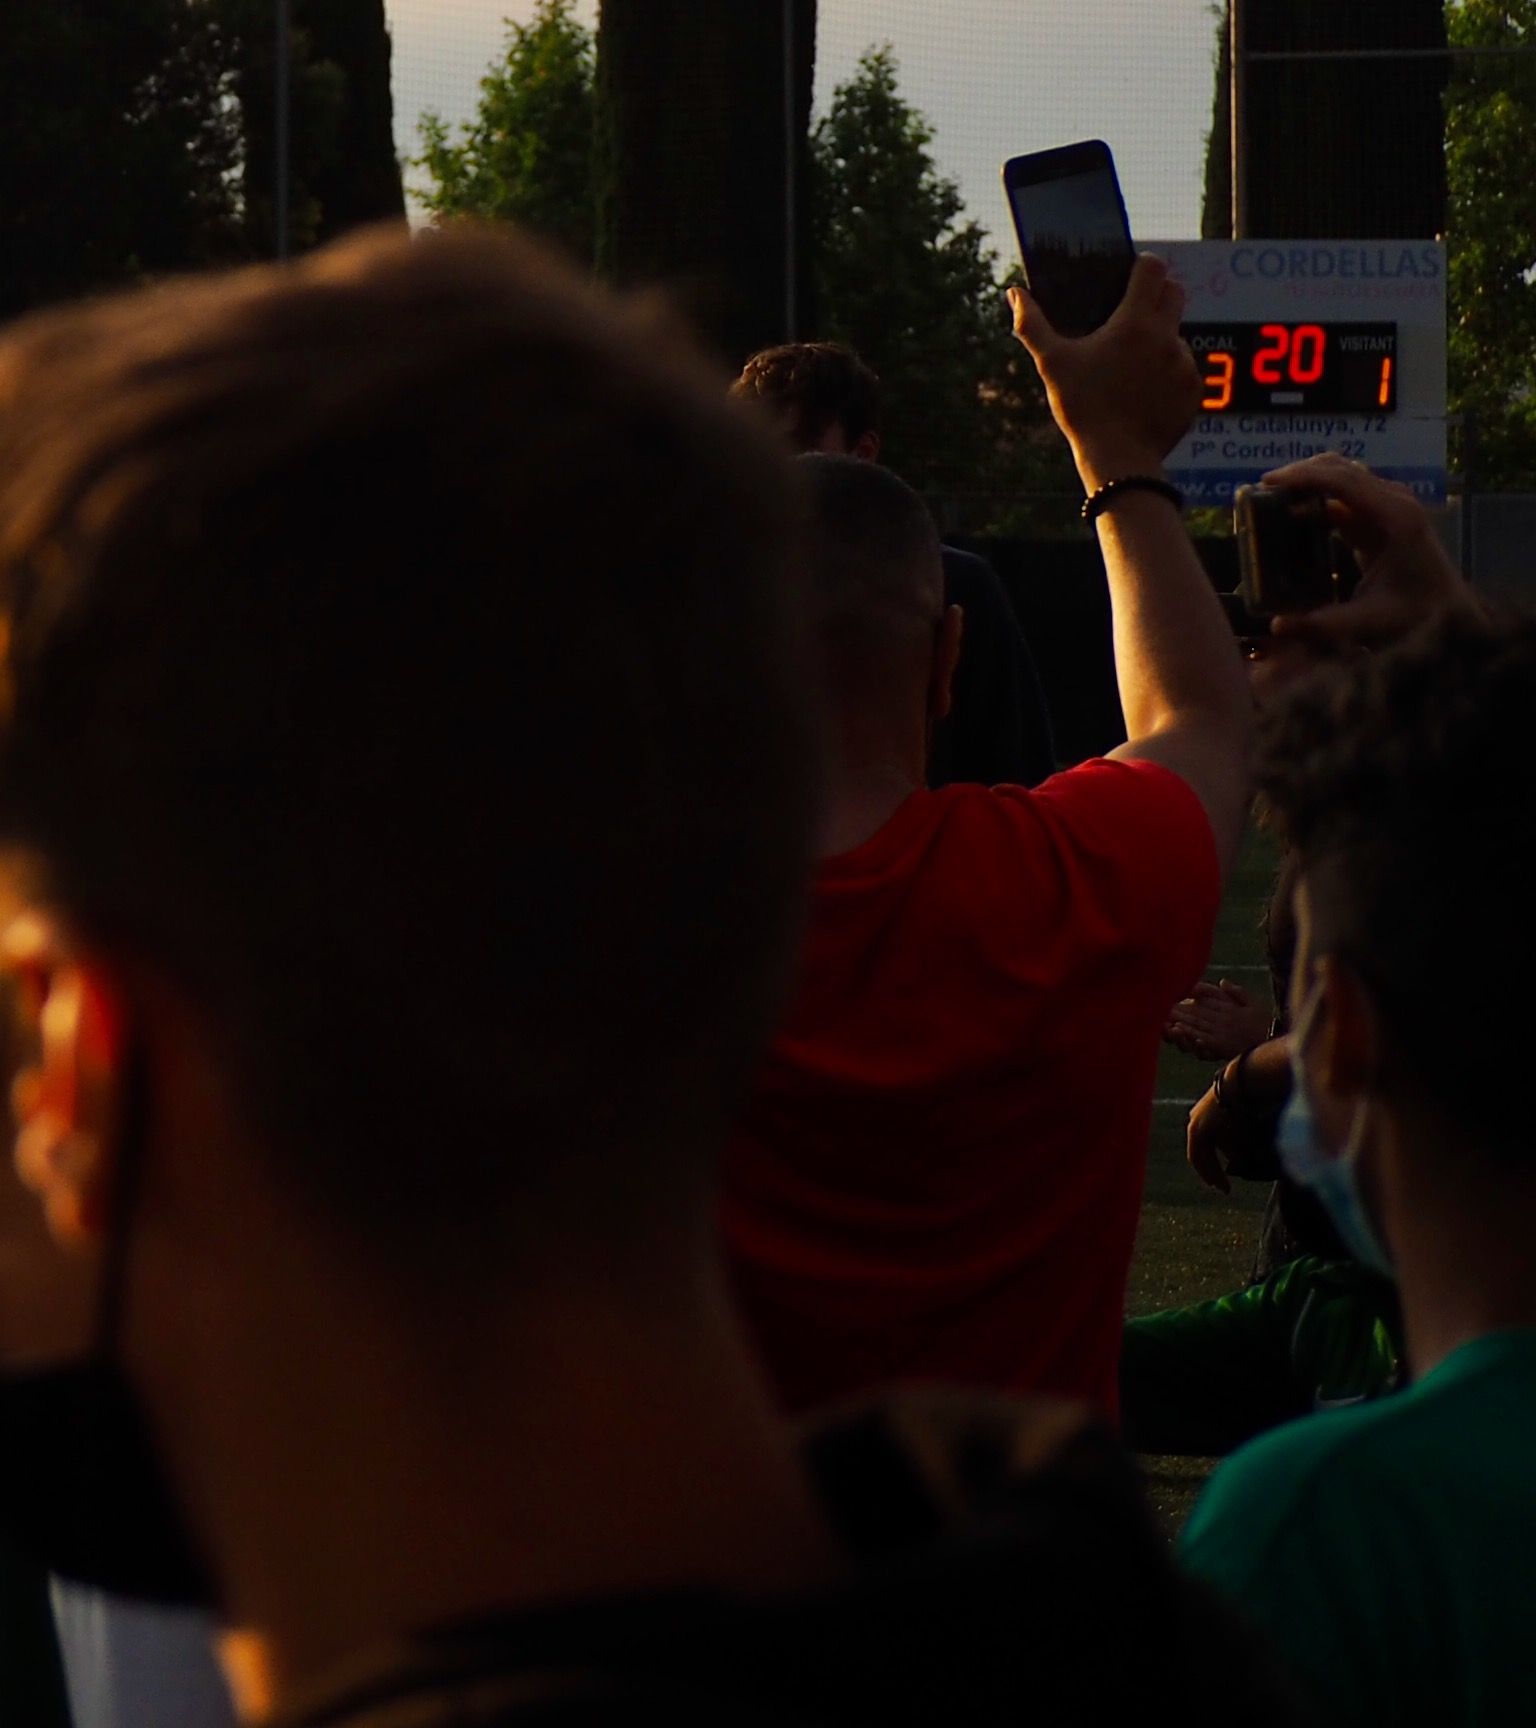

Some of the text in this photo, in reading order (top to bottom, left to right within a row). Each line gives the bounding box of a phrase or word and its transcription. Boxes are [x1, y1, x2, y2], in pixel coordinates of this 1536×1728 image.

[1230, 247, 1442, 278] CORDELLAS
[1191, 335, 1237, 351] OCAL
[1251, 323, 1328, 386] 20
[1339, 335, 1394, 351] VISITANT
[1199, 351, 1236, 411] 3
[1377, 354, 1393, 408] 1
[1238, 415, 1355, 436] Catalunya,
[1362, 414, 1387, 433] 72
[1341, 439, 1366, 458] 22
